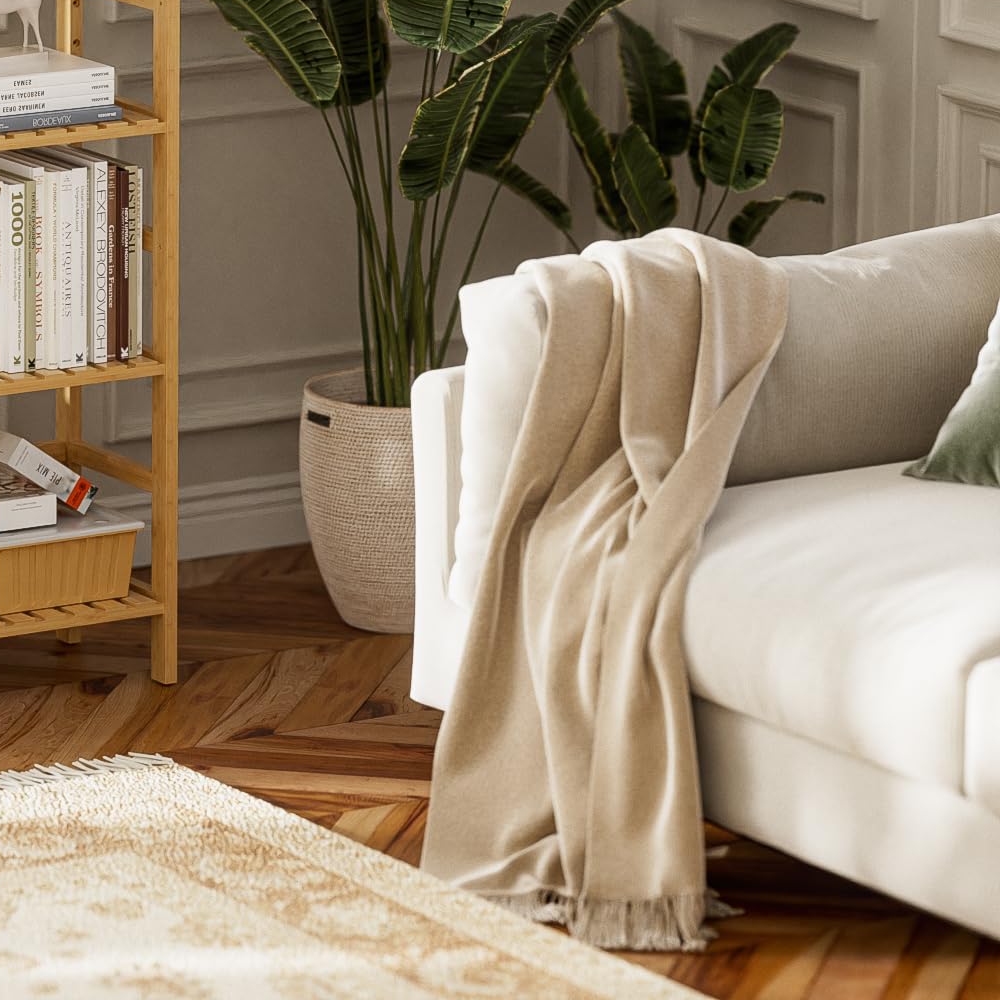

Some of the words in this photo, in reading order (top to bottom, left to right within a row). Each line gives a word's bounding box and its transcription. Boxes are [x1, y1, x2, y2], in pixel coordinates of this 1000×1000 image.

[11, 192, 23, 246] 1000
[97, 168, 106, 232] ALEXEY
[35, 216, 43, 255] BOOK
[108, 265, 115, 274] in
[35, 272, 43, 341] SYMBOLS
[97, 240, 106, 350] BRODOVITCH
[36, 463, 51, 477] MIX
[51, 471, 62, 486] PIE
